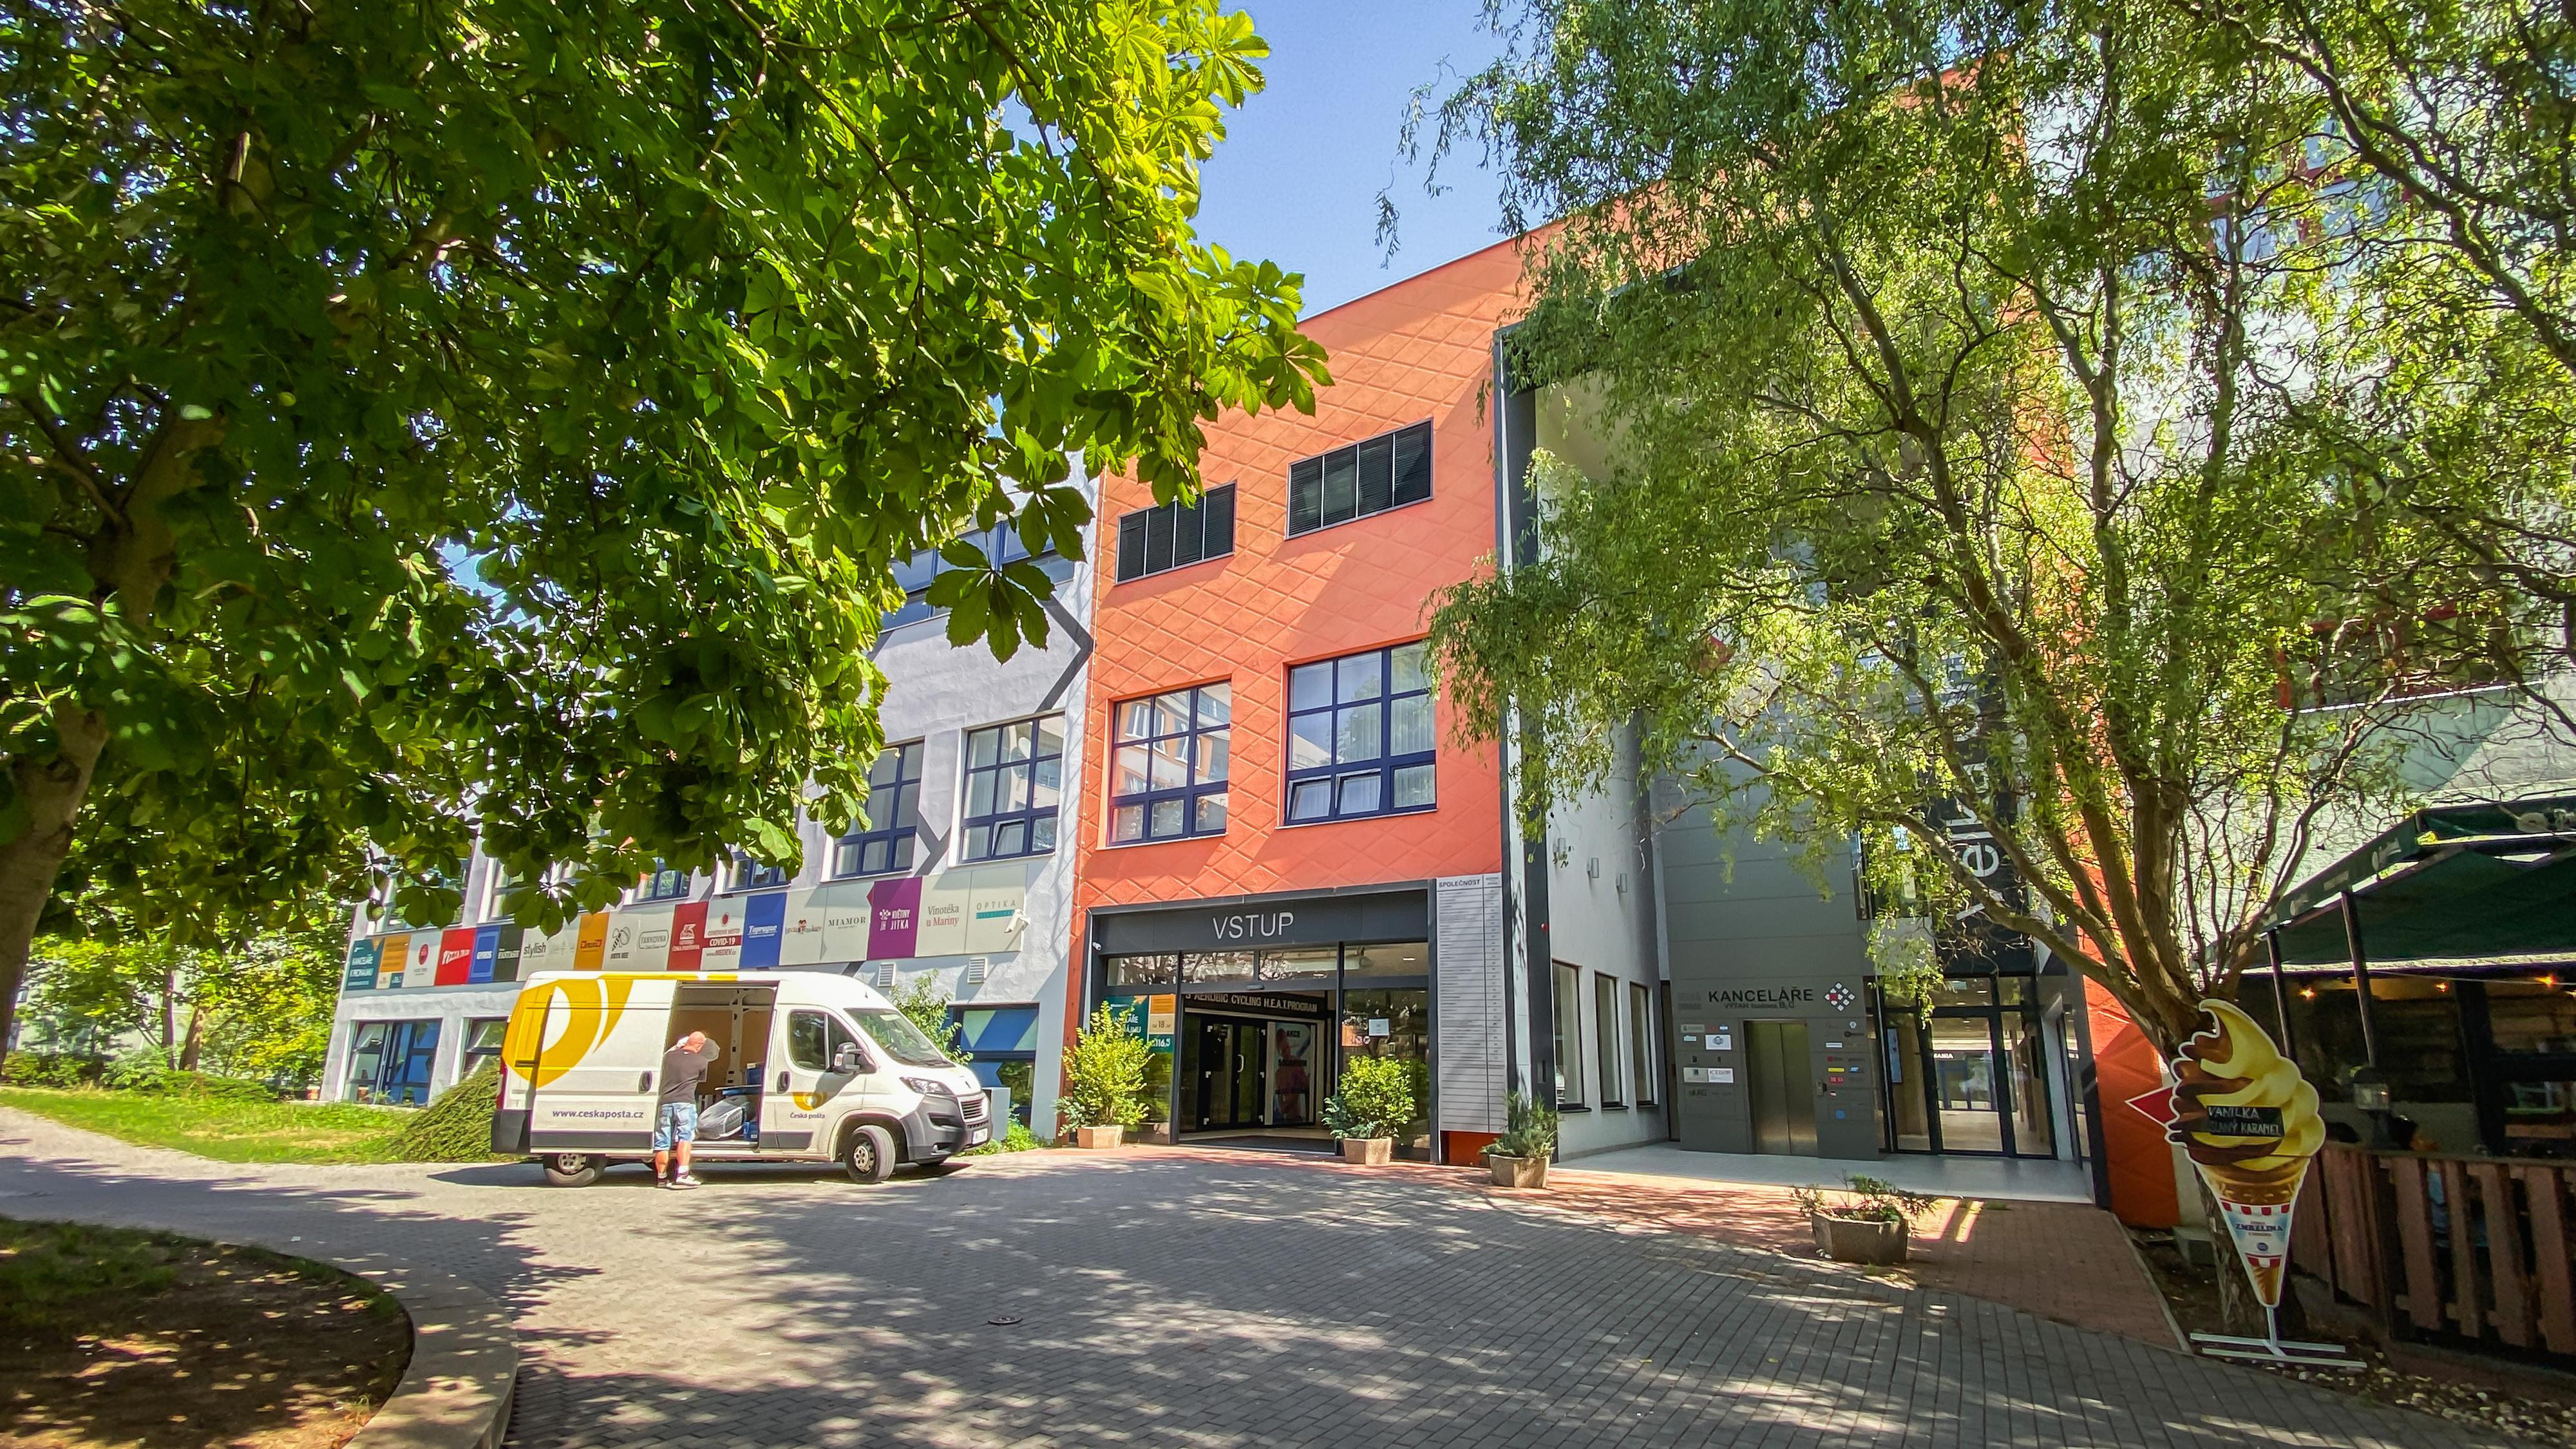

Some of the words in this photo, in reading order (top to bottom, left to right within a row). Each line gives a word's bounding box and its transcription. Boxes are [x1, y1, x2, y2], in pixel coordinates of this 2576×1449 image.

[1439, 879, 1481, 888] SPOLEČNOST
[928, 904, 960, 915] Vinotéka
[976, 900, 1016, 911] OPTIKA
[828, 916, 866, 927] MIAMOR
[890, 920, 909, 930] JITKA
[933, 916, 959, 927] Mariny
[1213, 912, 1294, 940] VSTUP
[710, 937, 735, 947] COVID-19
[524, 942, 546, 958] stylish
[1709, 987, 1814, 1002] KANCELÁŘE
[1231, 994, 1262, 1007] CYCLING
[552, 1110, 644, 1119] www.ceskaposta.cz
[2208, 1106, 2260, 1119] VANILKA
